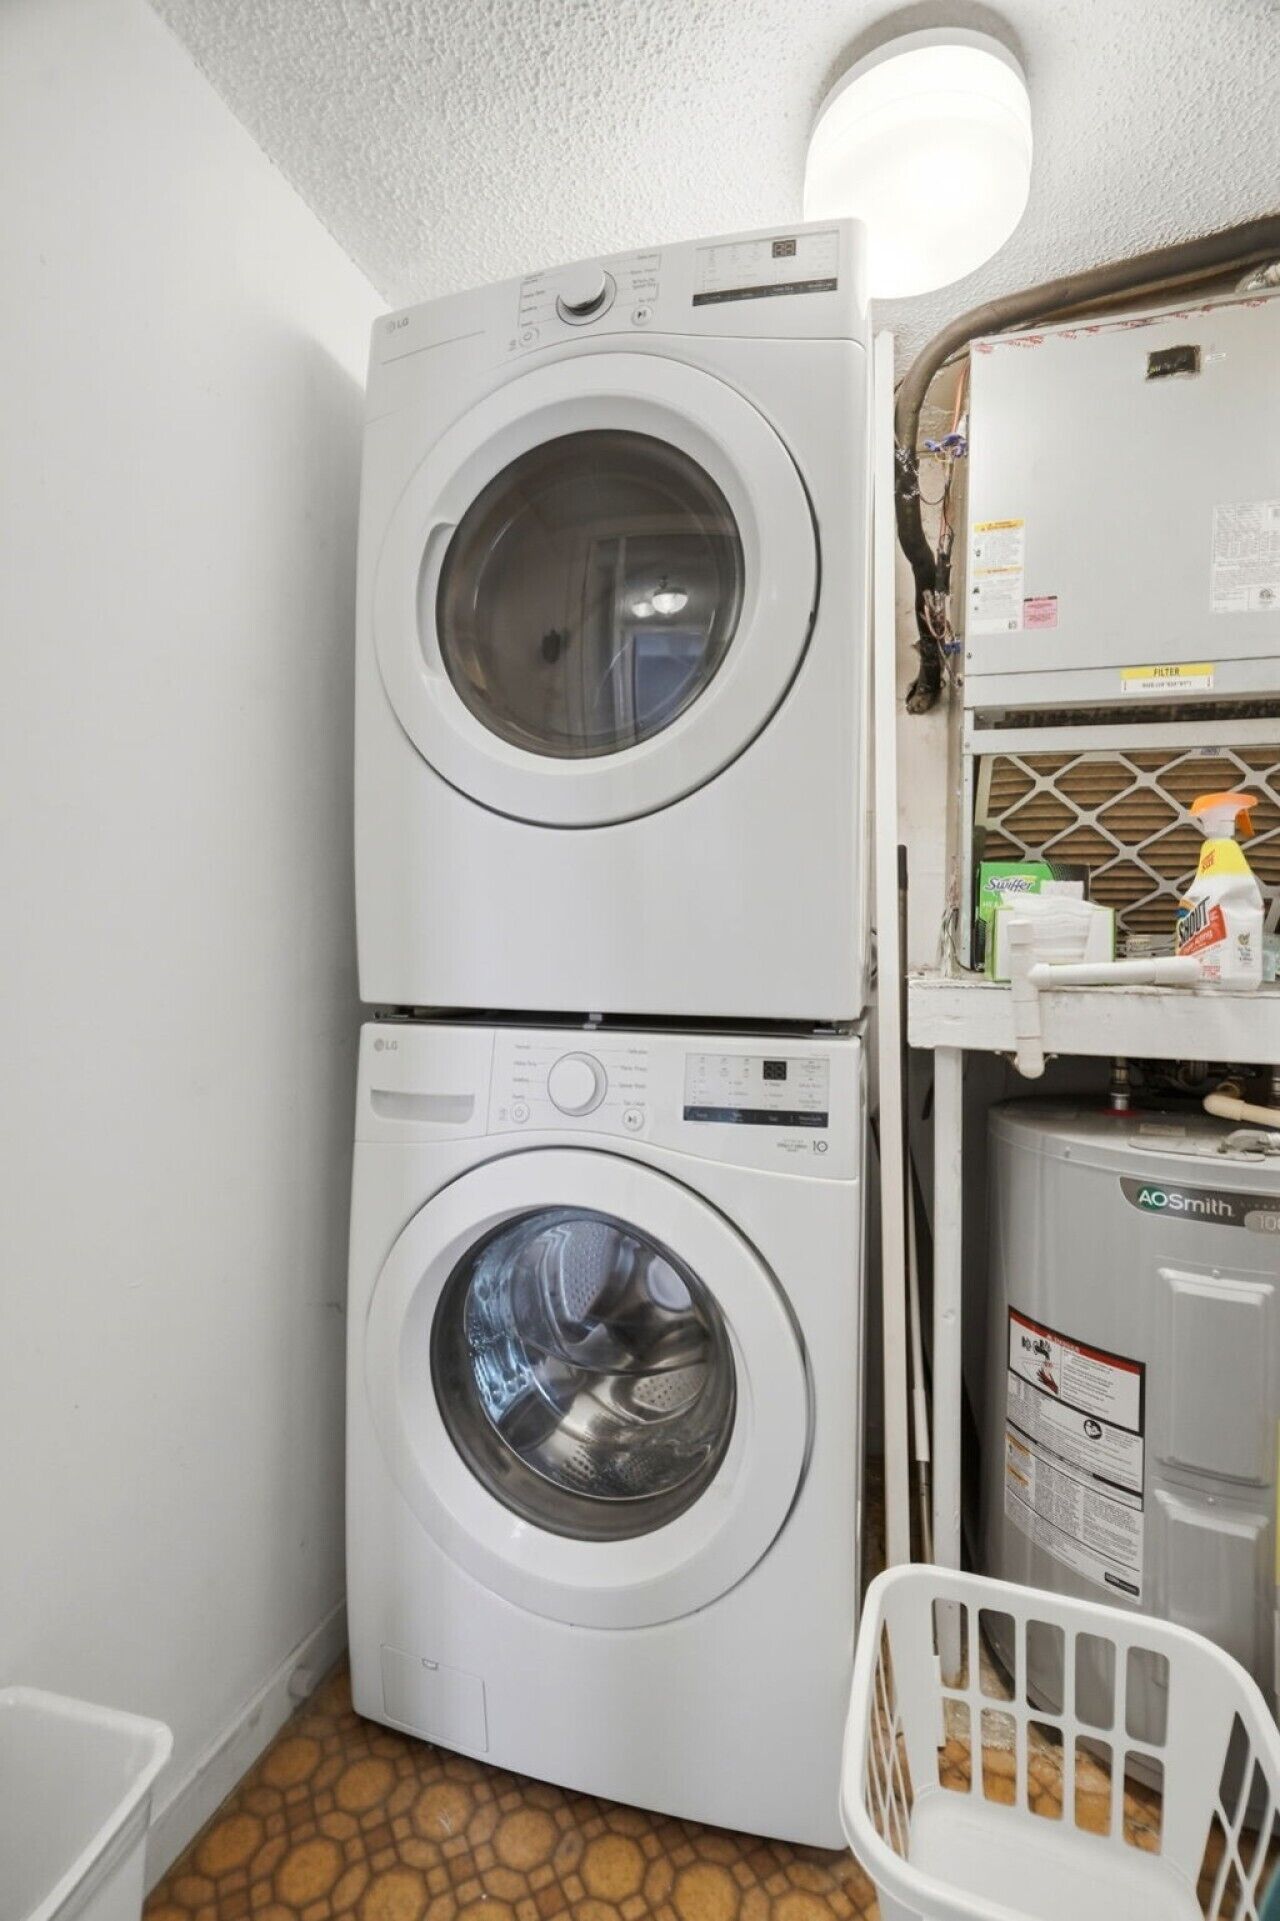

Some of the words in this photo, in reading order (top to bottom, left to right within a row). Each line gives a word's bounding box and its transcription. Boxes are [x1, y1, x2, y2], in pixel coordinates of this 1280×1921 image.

[1153, 667, 1180, 677] FILTER
[985, 877, 1033, 893] Swiffer
[1260, 1214, 1280, 1232] 10
